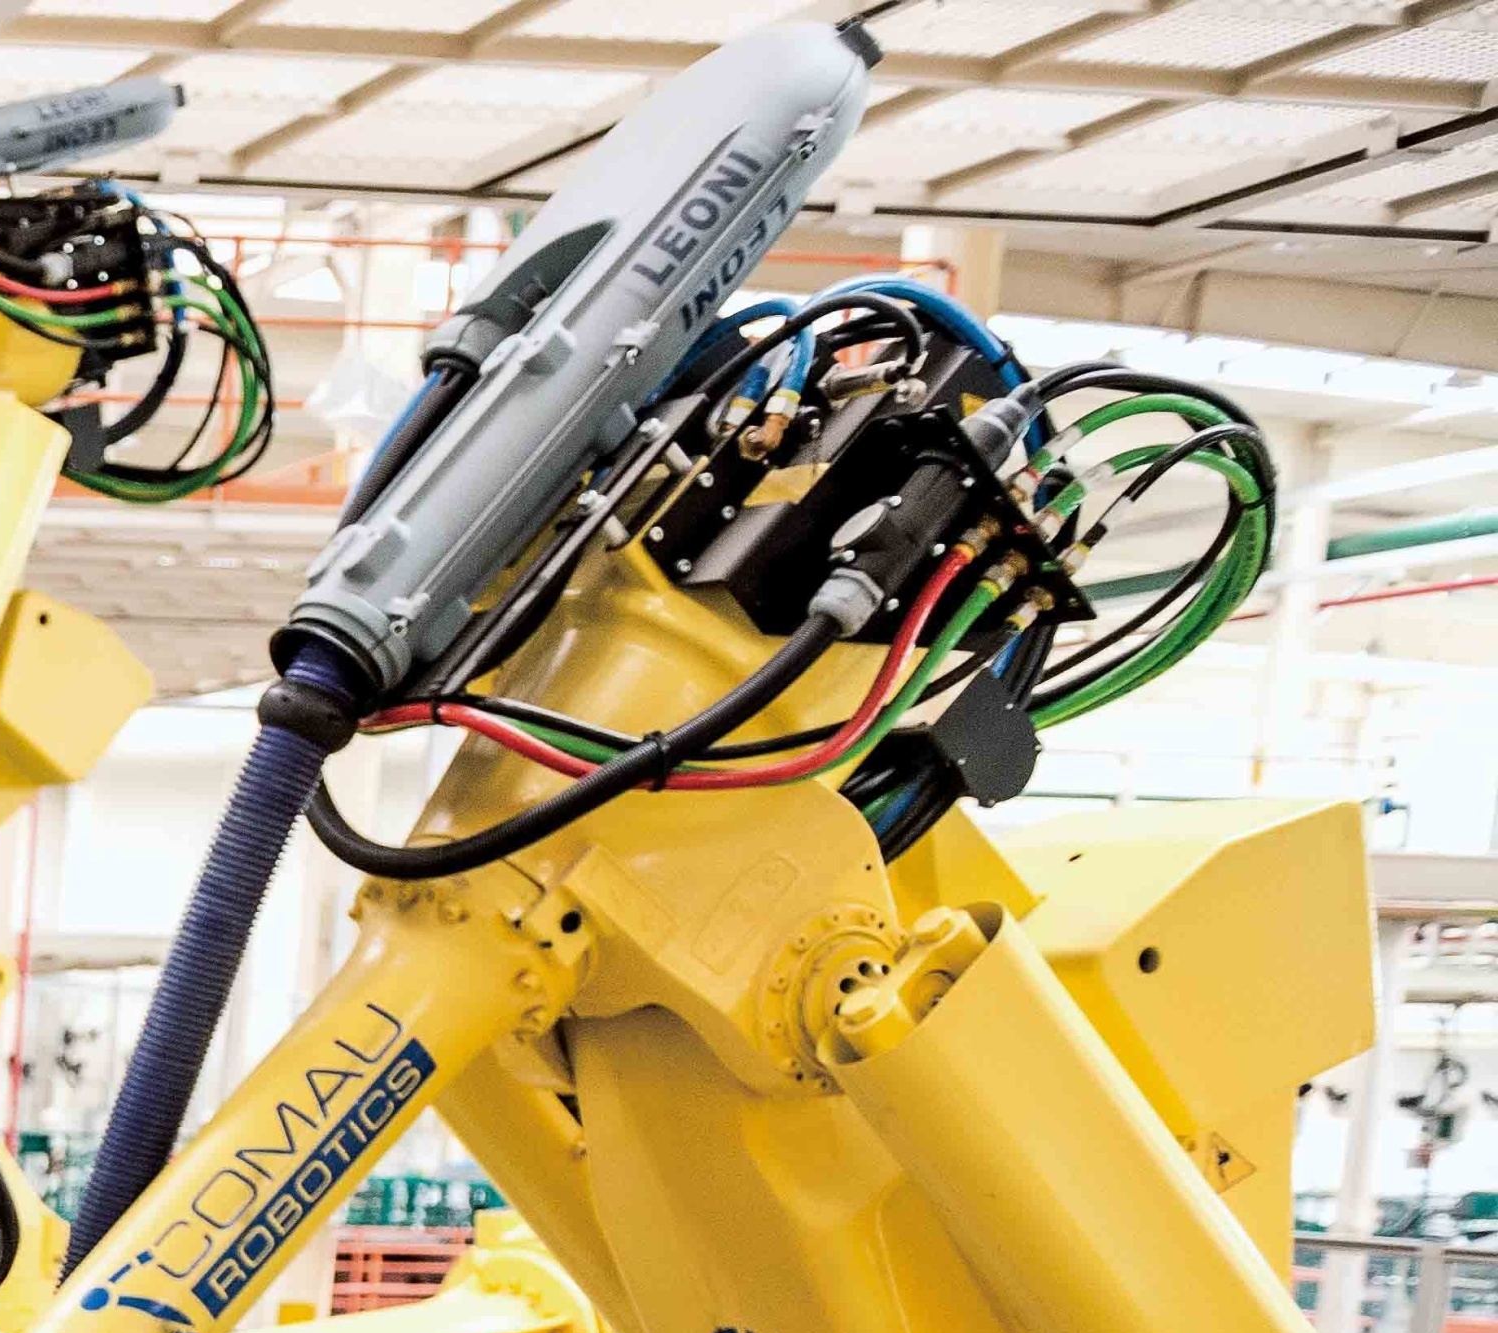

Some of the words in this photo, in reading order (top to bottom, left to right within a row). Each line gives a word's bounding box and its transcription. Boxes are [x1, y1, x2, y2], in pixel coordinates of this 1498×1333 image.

[631, 150, 763, 286] LEONI
[156, 1002, 403, 1279] COMAU
[207, 1057, 423, 1301] ROBOTICS
